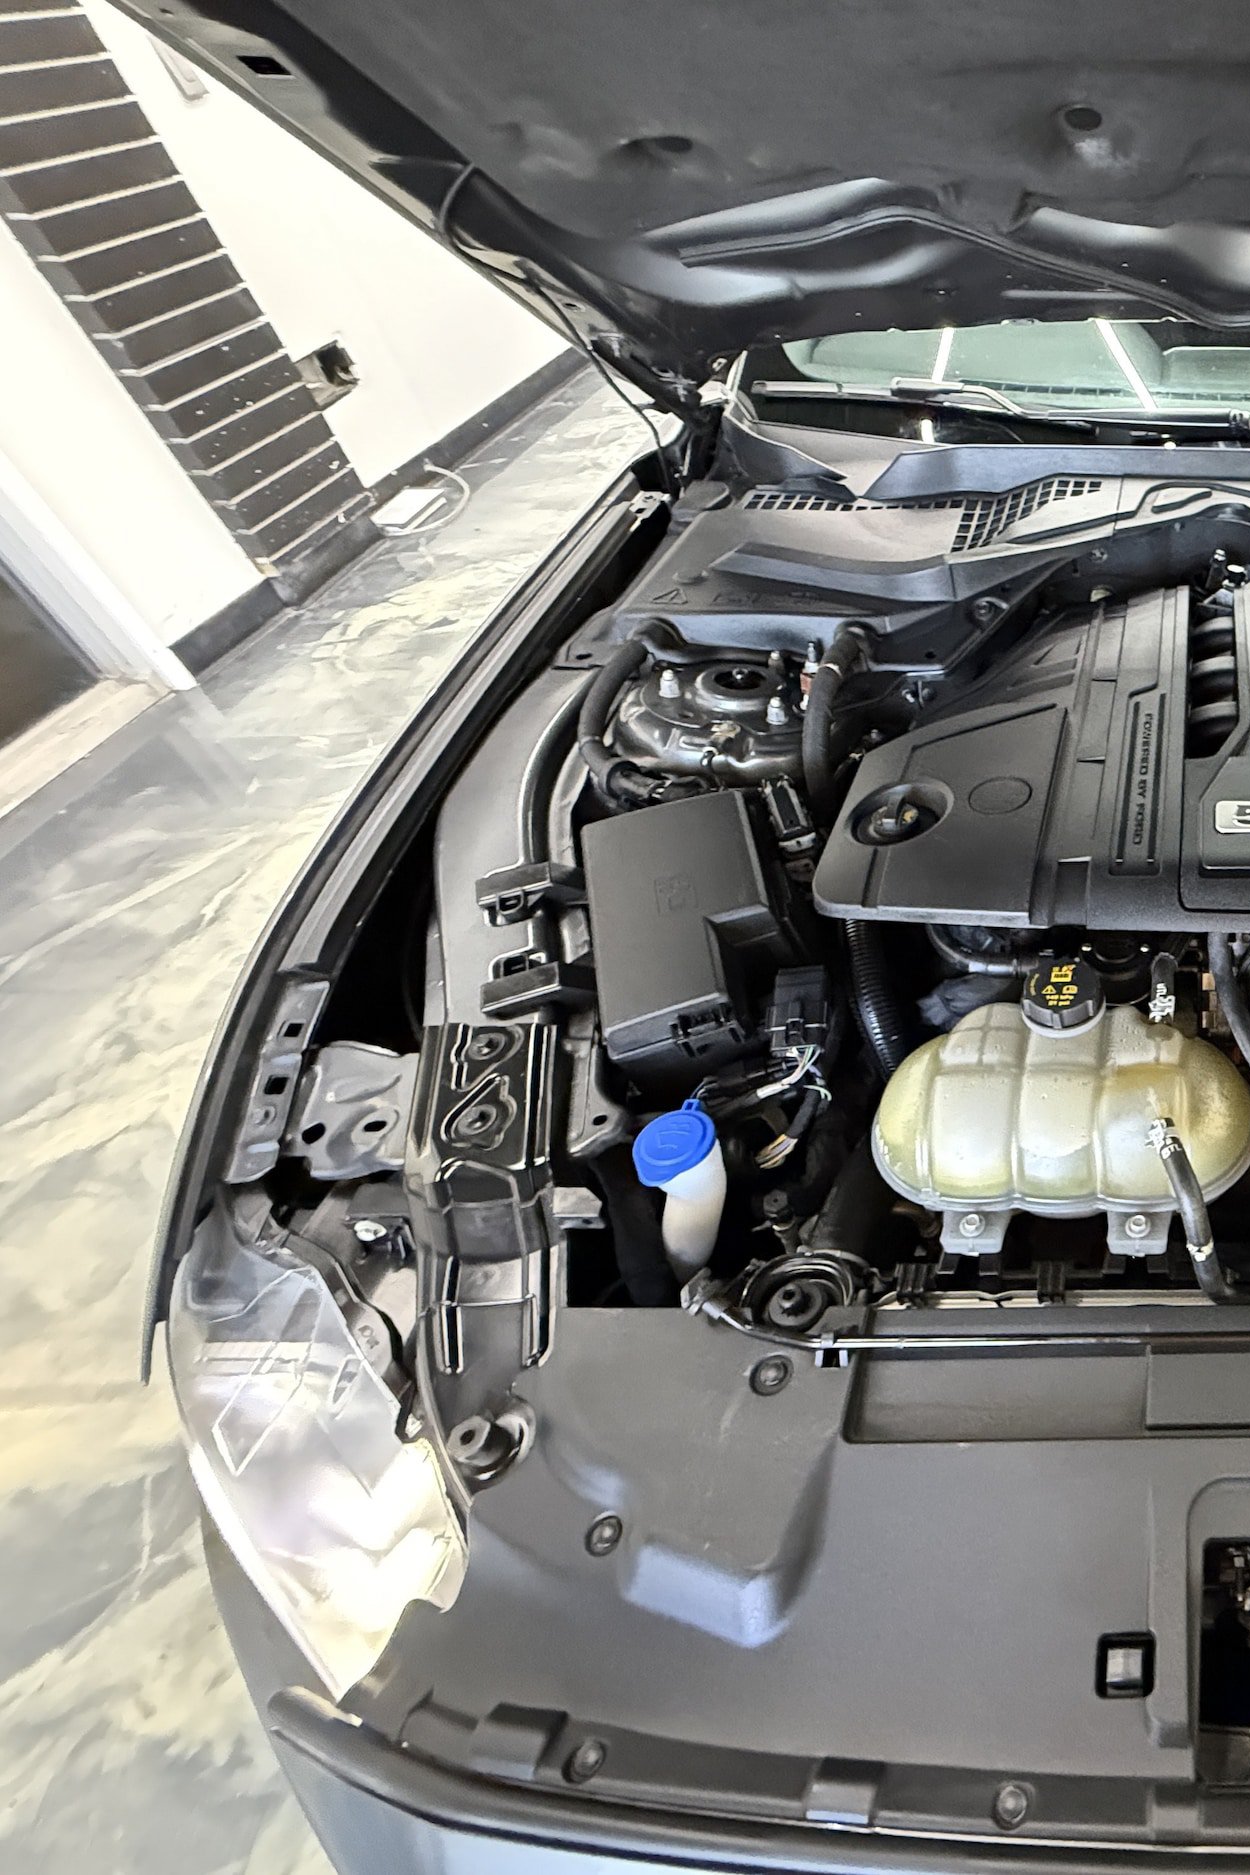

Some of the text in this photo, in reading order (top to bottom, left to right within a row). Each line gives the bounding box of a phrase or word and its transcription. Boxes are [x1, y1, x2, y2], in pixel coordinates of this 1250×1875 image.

[1133, 713, 1153, 845] POWERED BY FORD
